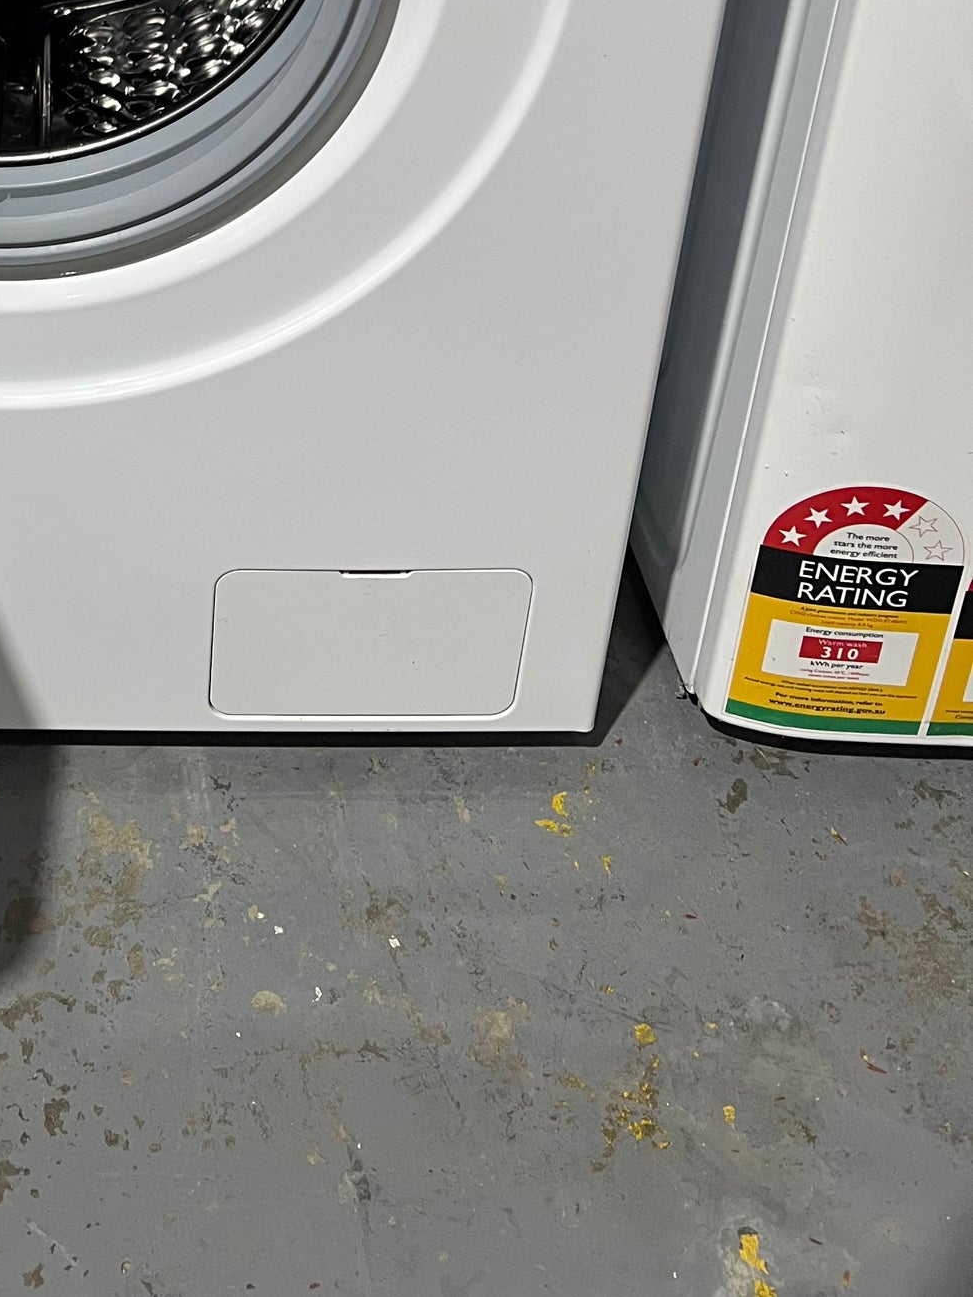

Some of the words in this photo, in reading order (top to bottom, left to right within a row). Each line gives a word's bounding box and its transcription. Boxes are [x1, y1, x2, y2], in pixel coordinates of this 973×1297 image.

[846, 531, 864, 541] The
[833, 540, 855, 548] stars
[857, 541, 872, 550] the
[830, 548, 861, 558] energy
[862, 550, 898, 559] efficient
[798, 559, 919, 587] ENERGY
[797, 581, 909, 608] RATING
[805, 626, 833, 636] Energy
[833, 630, 884, 639] consumption
[818, 638, 845, 647] Warm
[820, 646, 859, 661] 310
[810, 660, 830, 668] kWh
